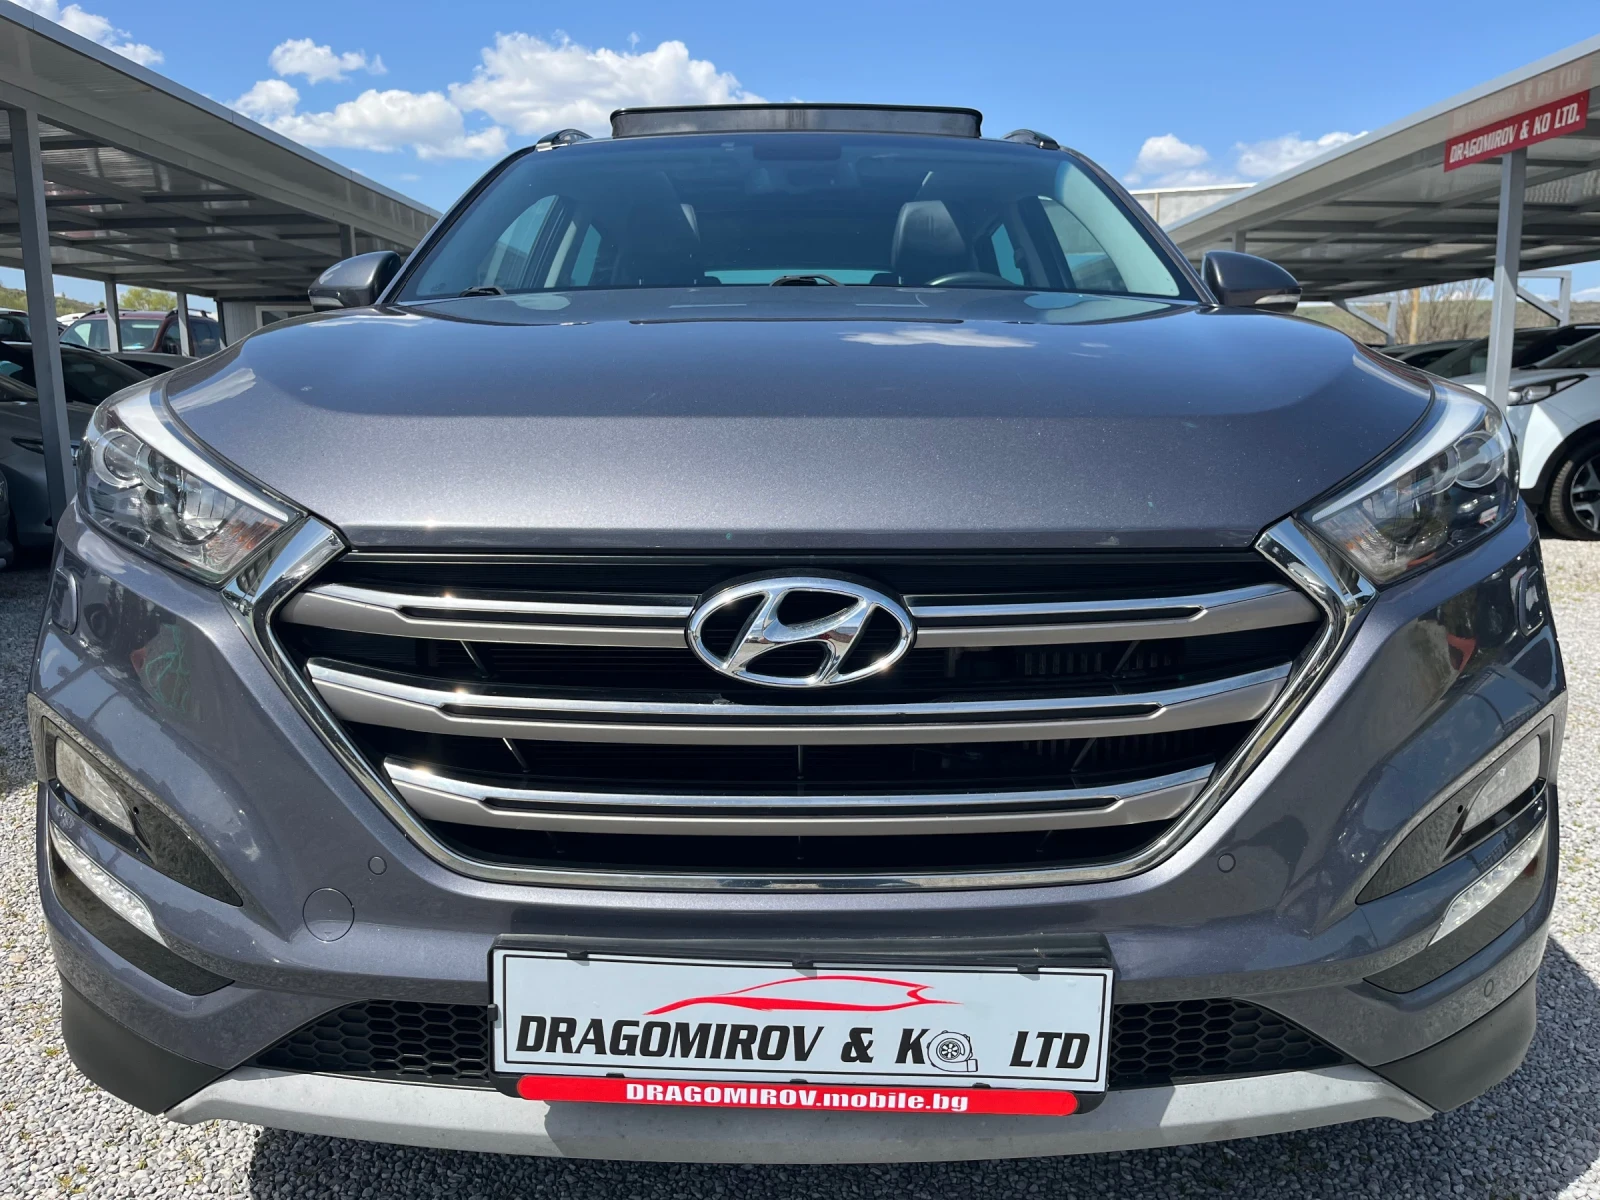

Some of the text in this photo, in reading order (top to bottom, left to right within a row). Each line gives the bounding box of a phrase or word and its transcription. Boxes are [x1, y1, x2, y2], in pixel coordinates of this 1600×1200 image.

[1449, 103, 1580, 163] DRAGOMIROV & KO LTD.
[516, 1015, 825, 1062] DRAGOMIROV
[840, 1027, 874, 1063] &
[1009, 1030, 1090, 1070] LTD
[626, 1083, 968, 1112] DRAGOMIROV.mobile.bg
